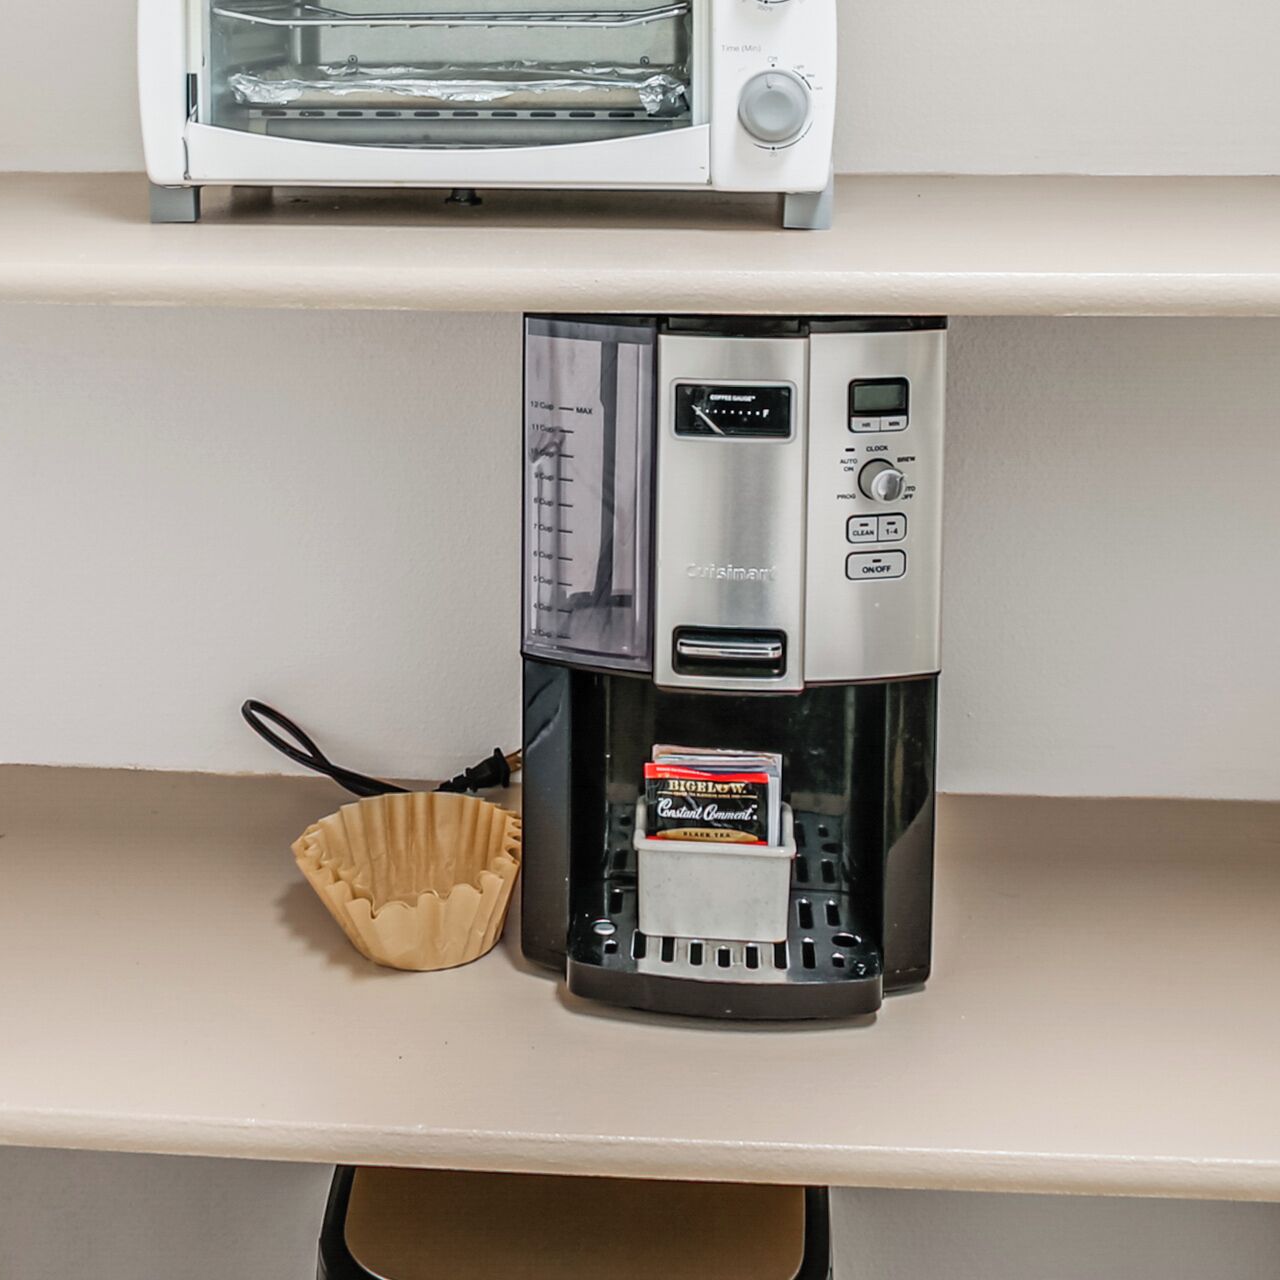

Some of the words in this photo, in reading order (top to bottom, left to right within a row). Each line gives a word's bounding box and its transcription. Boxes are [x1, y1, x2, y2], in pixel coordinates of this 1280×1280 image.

[576, 407, 593, 415] MAX
[866, 445, 889, 453] CLOCK
[852, 529, 875, 537] CLEAN
[885, 528, 898, 536] 1-4
[862, 565, 891, 574] ON/OFF
